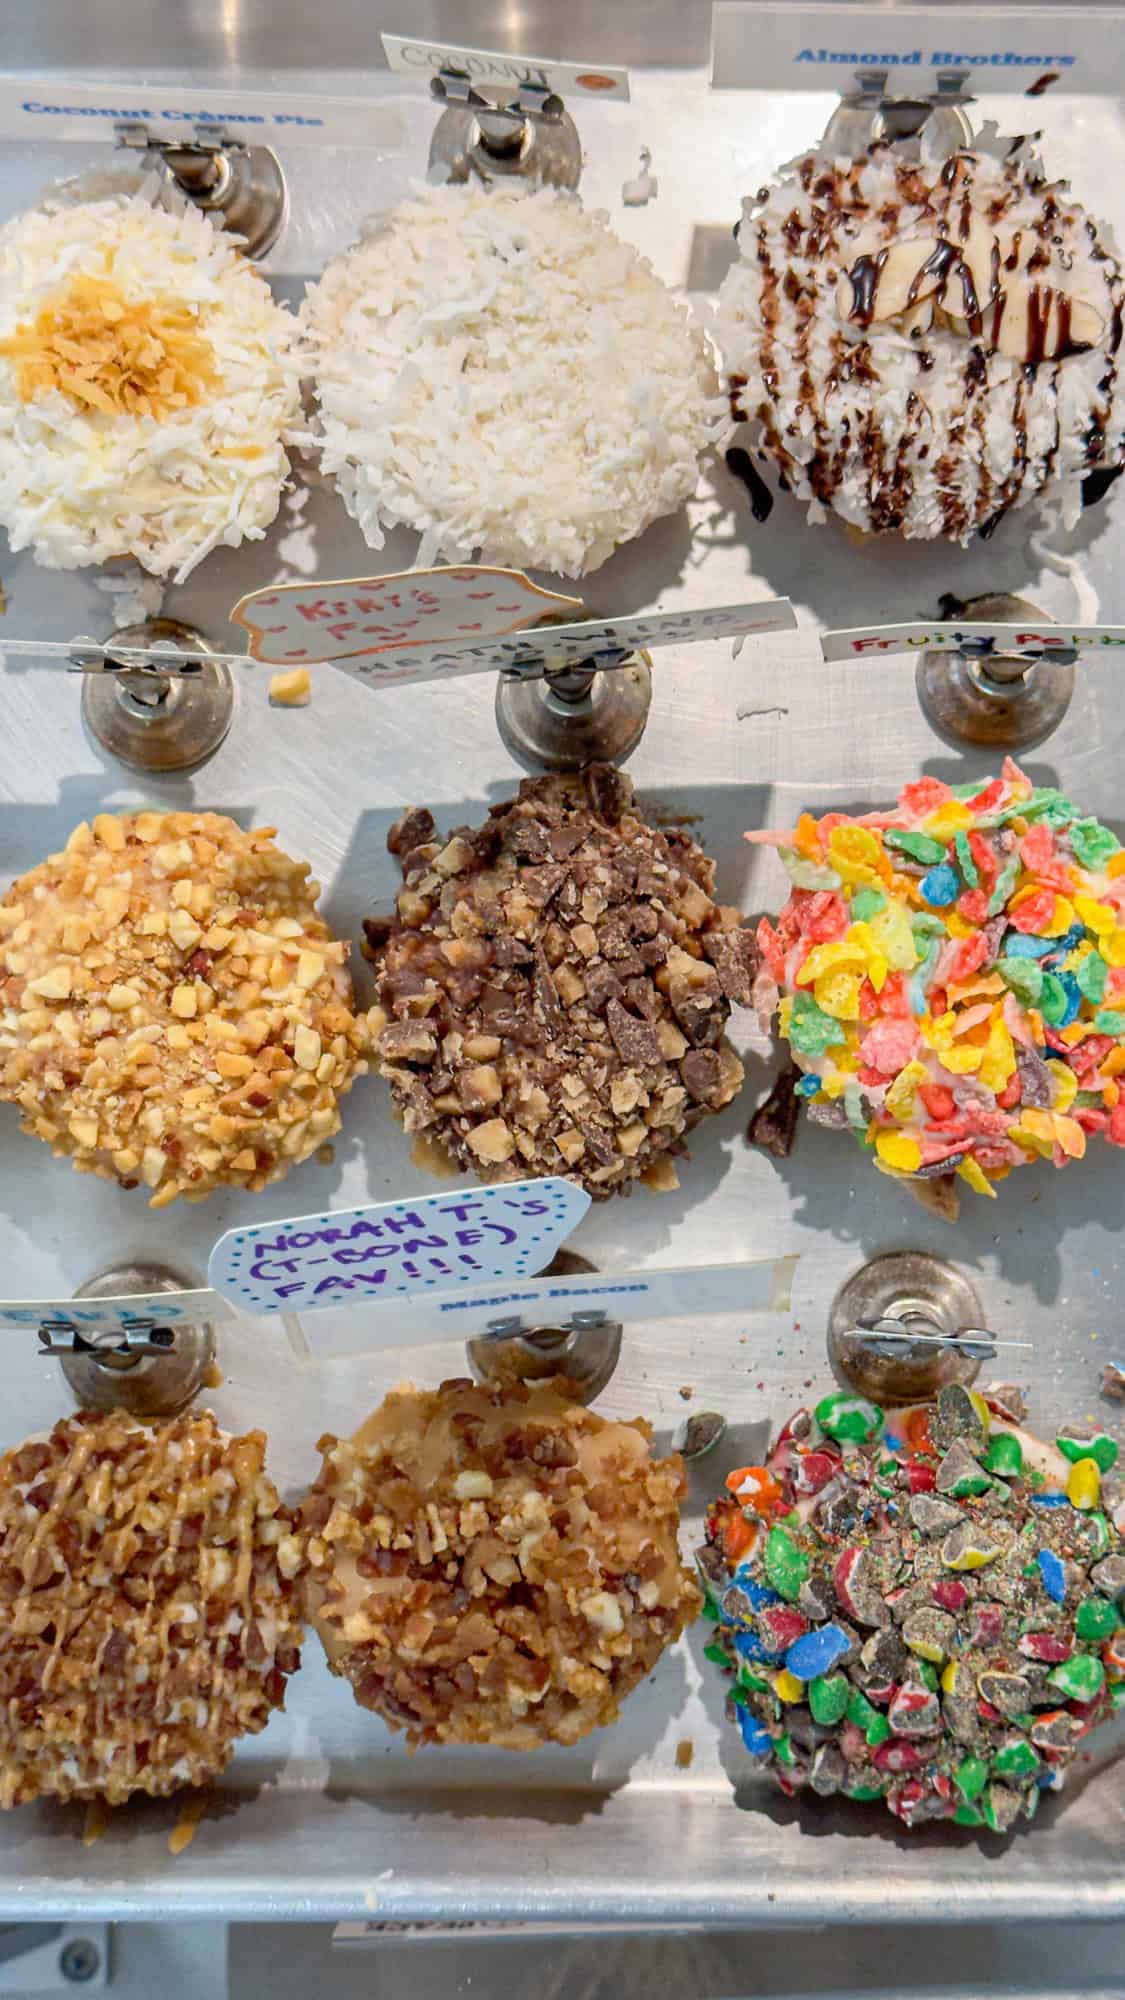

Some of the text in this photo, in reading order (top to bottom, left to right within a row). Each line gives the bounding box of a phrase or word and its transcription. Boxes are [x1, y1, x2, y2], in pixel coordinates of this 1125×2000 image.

[793, 48, 1077, 67] Almond Brothers
[21, 101, 153, 119] Coconut
[851, 631, 996, 653] Fruity
[254, 1212, 426, 1258] NORAH
[249, 1223, 518, 1280] (T-BONE)
[272, 1253, 484, 1298] FAV!!!
[440, 1283, 649, 1312] Maple Bacon
